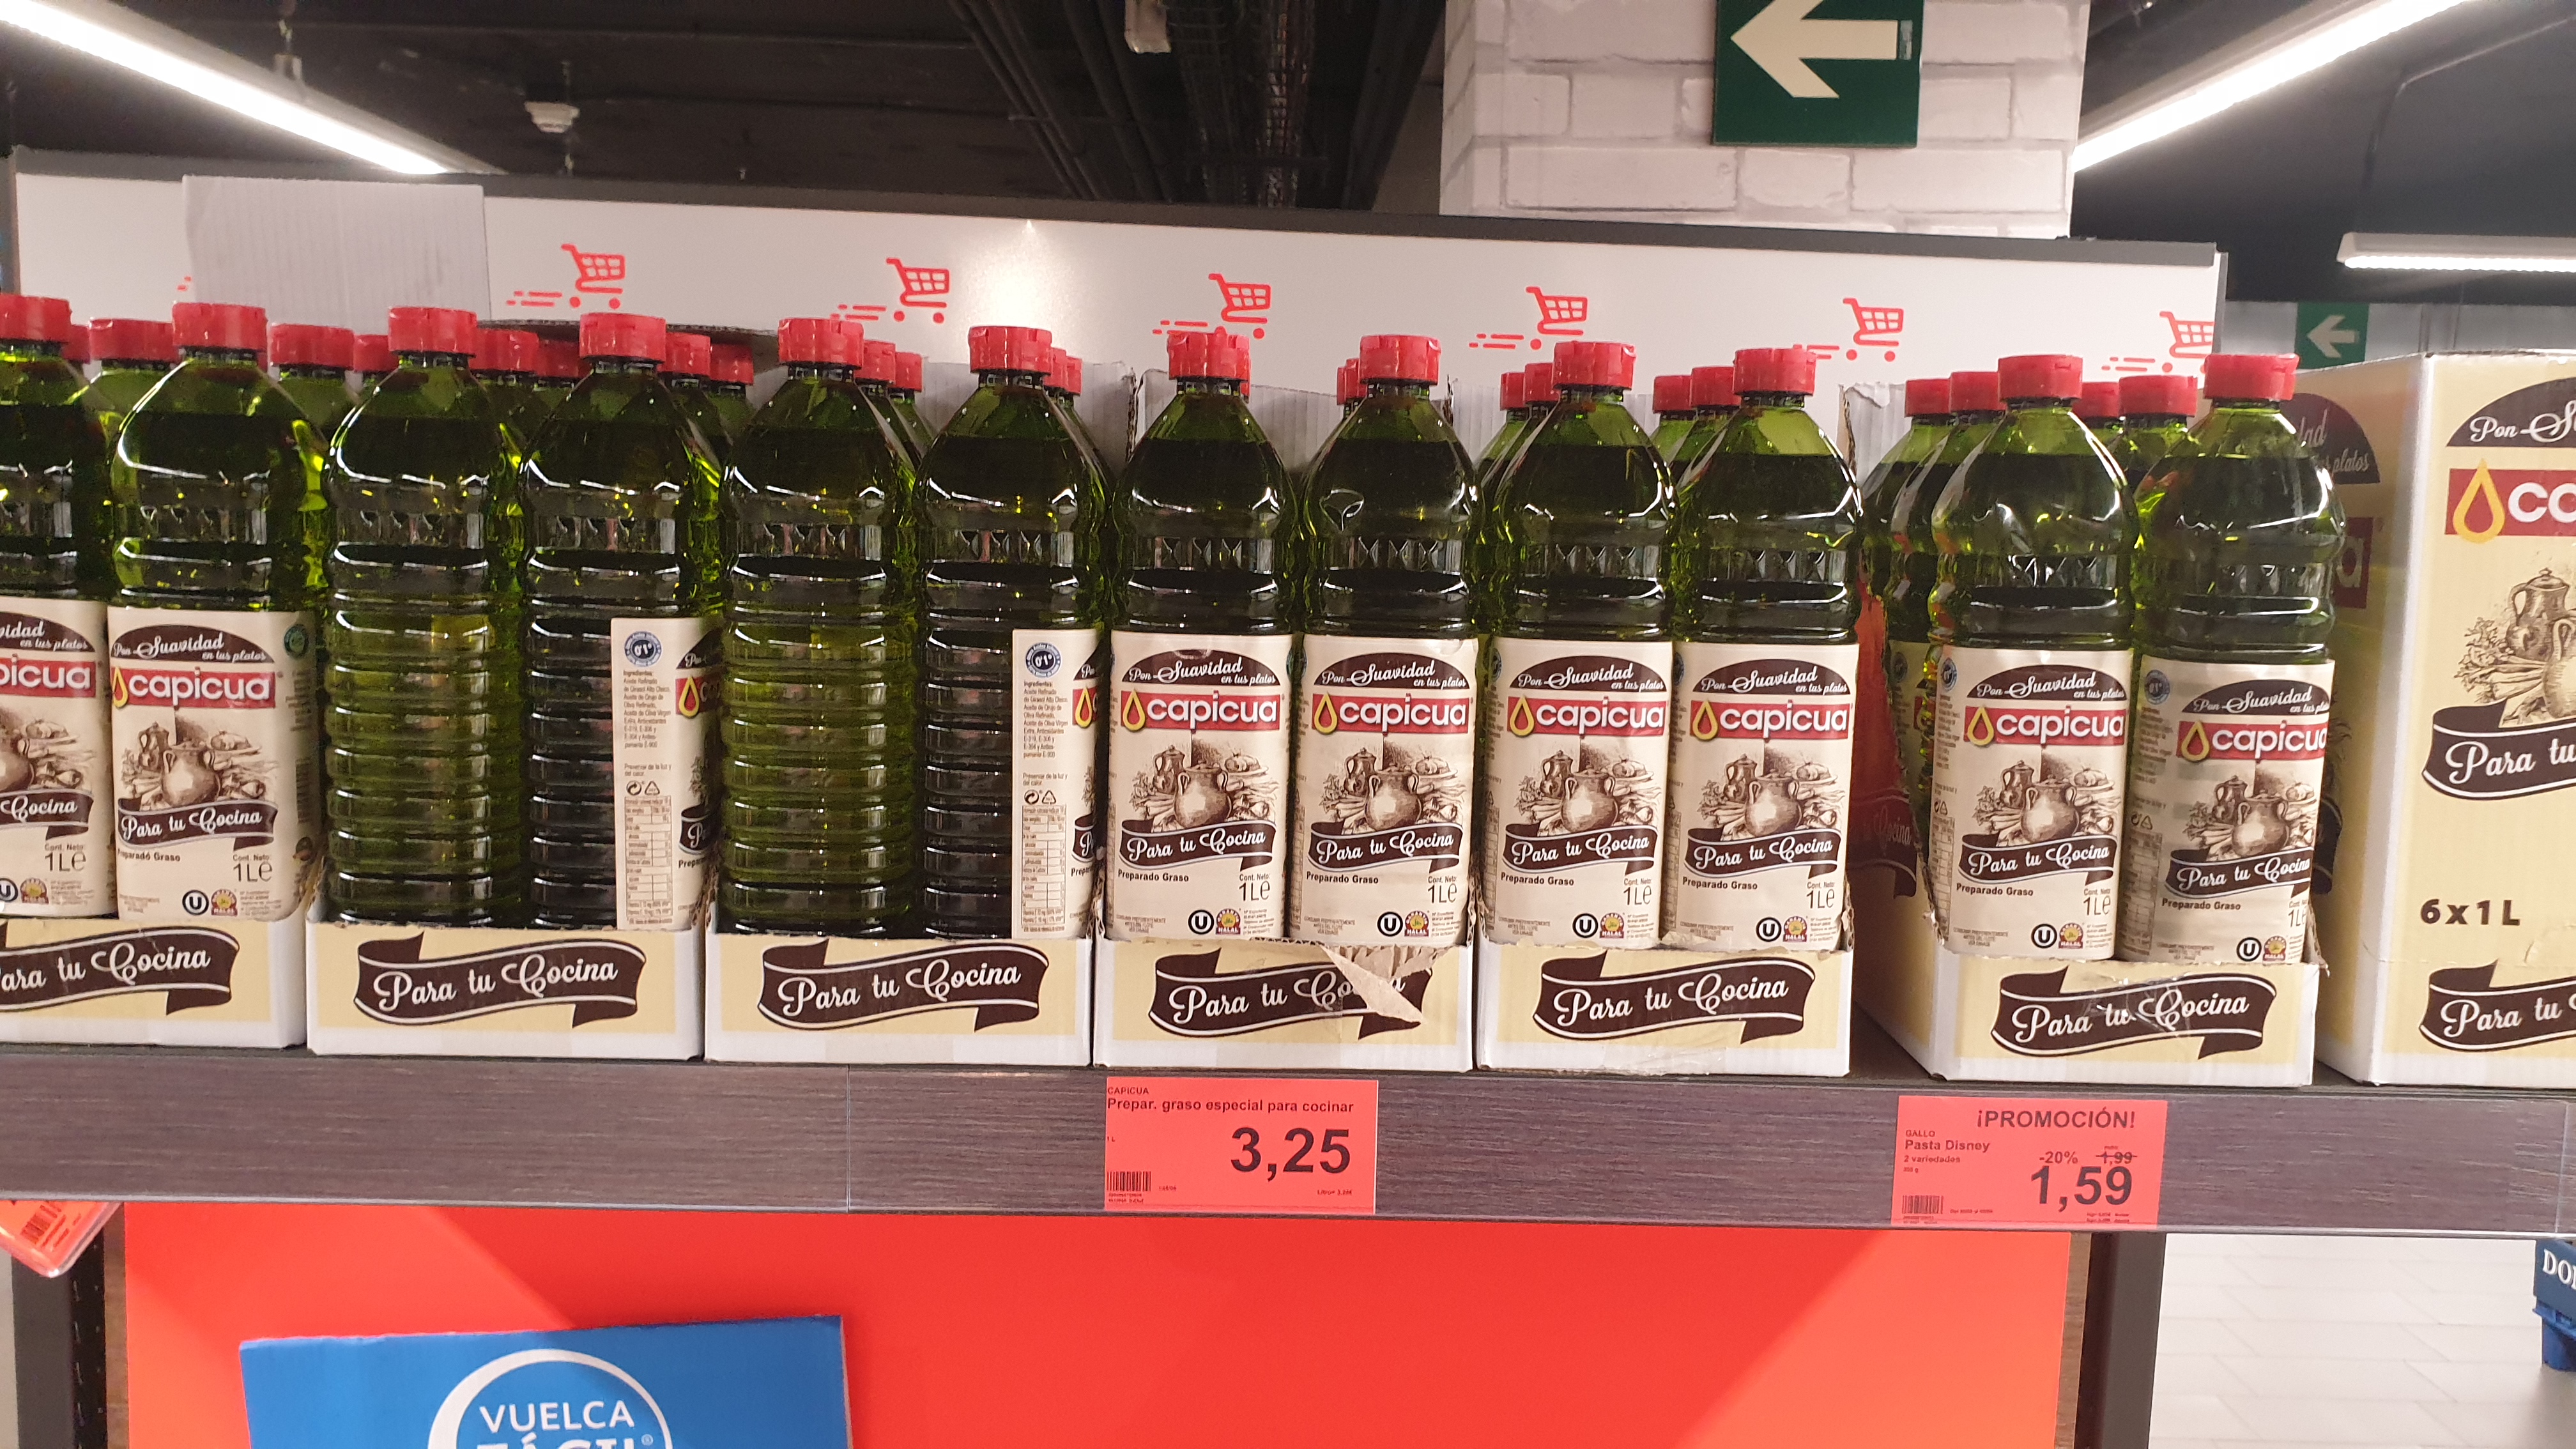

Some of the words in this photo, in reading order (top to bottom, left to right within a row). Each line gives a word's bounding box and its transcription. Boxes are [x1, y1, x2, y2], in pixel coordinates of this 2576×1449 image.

[2470, 416, 2518, 442] Pon
[35, 639, 51, 648] tus
[54, 639, 88, 651] platos
[134, 632, 224, 657] Suavidad
[203, 651, 215, 660] en
[217, 649, 230, 660] tus
[232, 650, 266, 663] platos
[1129, 668, 1152, 682] Pon
[1153, 656, 1243, 683] Suavidad
[1234, 674, 1248, 684] tus
[1248, 674, 1276, 687] platos
[1321, 671, 1345, 684] Pon
[1346, 659, 1435, 687] Suavidad
[1517, 674, 1542, 687] Pon
[1544, 663, 1634, 689] Suavidad
[1701, 678, 1726, 691] Pon
[1728, 666, 1818, 693] Suavidad
[129, 667, 270, 705] capicua
[1414, 678, 1425, 687] en
[1427, 677, 1440, 687] tus
[1441, 677, 1466, 690] platos
[1611, 681, 1623, 690] en
[1624, 680, 1639, 690] tus
[1639, 680, 1664, 693] platos
[1795, 684, 1807, 693] en
[1809, 683, 1822, 693] tus
[1823, 682, 1847, 696] platos
[1977, 684, 2003, 697] Pon
[2004, 671, 2096, 698] Suavidad
[2074, 689, 2085, 698] en
[2087, 689, 2101, 698] tus
[1147, 692, 1276, 729] capicua
[1340, 695, 1466, 732] capicua
[2221, 686, 2312, 714] Suavidad
[2290, 704, 2301, 713] en
[2303, 703, 2315, 713] tus
[1537, 698, 1664, 735] capicua
[1720, 702, 1848, 739] capicua
[1997, 708, 2124, 744] capicua
[2446, 740, 2535, 785] Para
[0, 795, 77, 822] Cocina
[121, 815, 162, 839] Para
[169, 815, 186, 832] tu
[190, 808, 263, 834] Cocina
[153, 852, 181, 862] Graso
[1127, 838, 1173, 862] Para
[1180, 837, 1196, 852] tu
[1199, 827, 1266, 854] Cocina
[1316, 839, 1363, 864] Para
[1370, 839, 1386, 854] tu
[1390, 831, 1453, 857] Cocina
[1511, 841, 1559, 864] Para
[1565, 841, 1582, 857] tu
[1585, 832, 1650, 859] Cocina
[1694, 846, 1742, 870] Para
[1749, 845, 1765, 861] tu
[1769, 836, 1833, 862] Cocina
[1968, 852, 2018, 876] Para
[2025, 851, 2041, 867] tu
[2045, 843, 2110, 869] Cocina
[1118, 868, 1160, 881] Preparado
[1162, 873, 1189, 882] Graso
[1307, 871, 1349, 884] Preparado
[1352, 875, 1379, 884] Graso
[1501, 872, 1544, 885] Preparado
[1547, 877, 1574, 886] Graso
[1682, 877, 1728, 889] Preparado
[1731, 882, 1758, 890] Graso
[2176, 867, 2227, 891] Para
[2235, 866, 2251, 881] tu
[1956, 883, 2003, 896] Preparado
[2006, 887, 2034, 896] Graso
[2162, 898, 2211, 910] Preparado
[2214, 901, 2241, 910] Graso
[0, 967, 46, 991] ara
[58, 957, 86, 981] tu
[91, 942, 211, 985] Cocina
[374, 970, 457, 1011] Para
[468, 969, 496, 995] tu
[502, 954, 618, 998] Cocina
[778, 976, 861, 1016] Para
[872, 975, 900, 998] tu
[905, 959, 1022, 1002] Cocina
[1169, 985, 1248, 1023] Para
[1261, 983, 1288, 1007] tu
[1553, 988, 1632, 1027] Para
[1644, 986, 1672, 1010] tu
[1678, 973, 1789, 1015] Cocina
[2012, 1004, 2092, 1043] Para
[2138, 989, 2249, 1031] Cocina
[2440, 999, 2521, 1038] Para
[2534, 997, 2563, 1020] tu
[1107, 1087, 1149, 1095] CAPICUA
[1107, 1098, 1156, 1112] Prepar.
[1162, 1100, 1201, 1113] graso
[1206, 1099, 1263, 1113] especial
[1268, 1102, 1298, 1114] para
[1303, 1101, 1354, 1112] cocinar
[1977, 1107, 2135, 1129] ¡PROMOCIÓN!
[1230, 1127, 1350, 1182] 3,25
[1905, 1139, 1940, 1151] Pasta
[1945, 1140, 1990, 1153] Disney
[1912, 1155, 1960, 1163] variedades
[2039, 1151, 2078, 1164] -20%
[2031, 1165, 2133, 1213] 1,59
[479, 1400, 635, 1433] VUELCA
